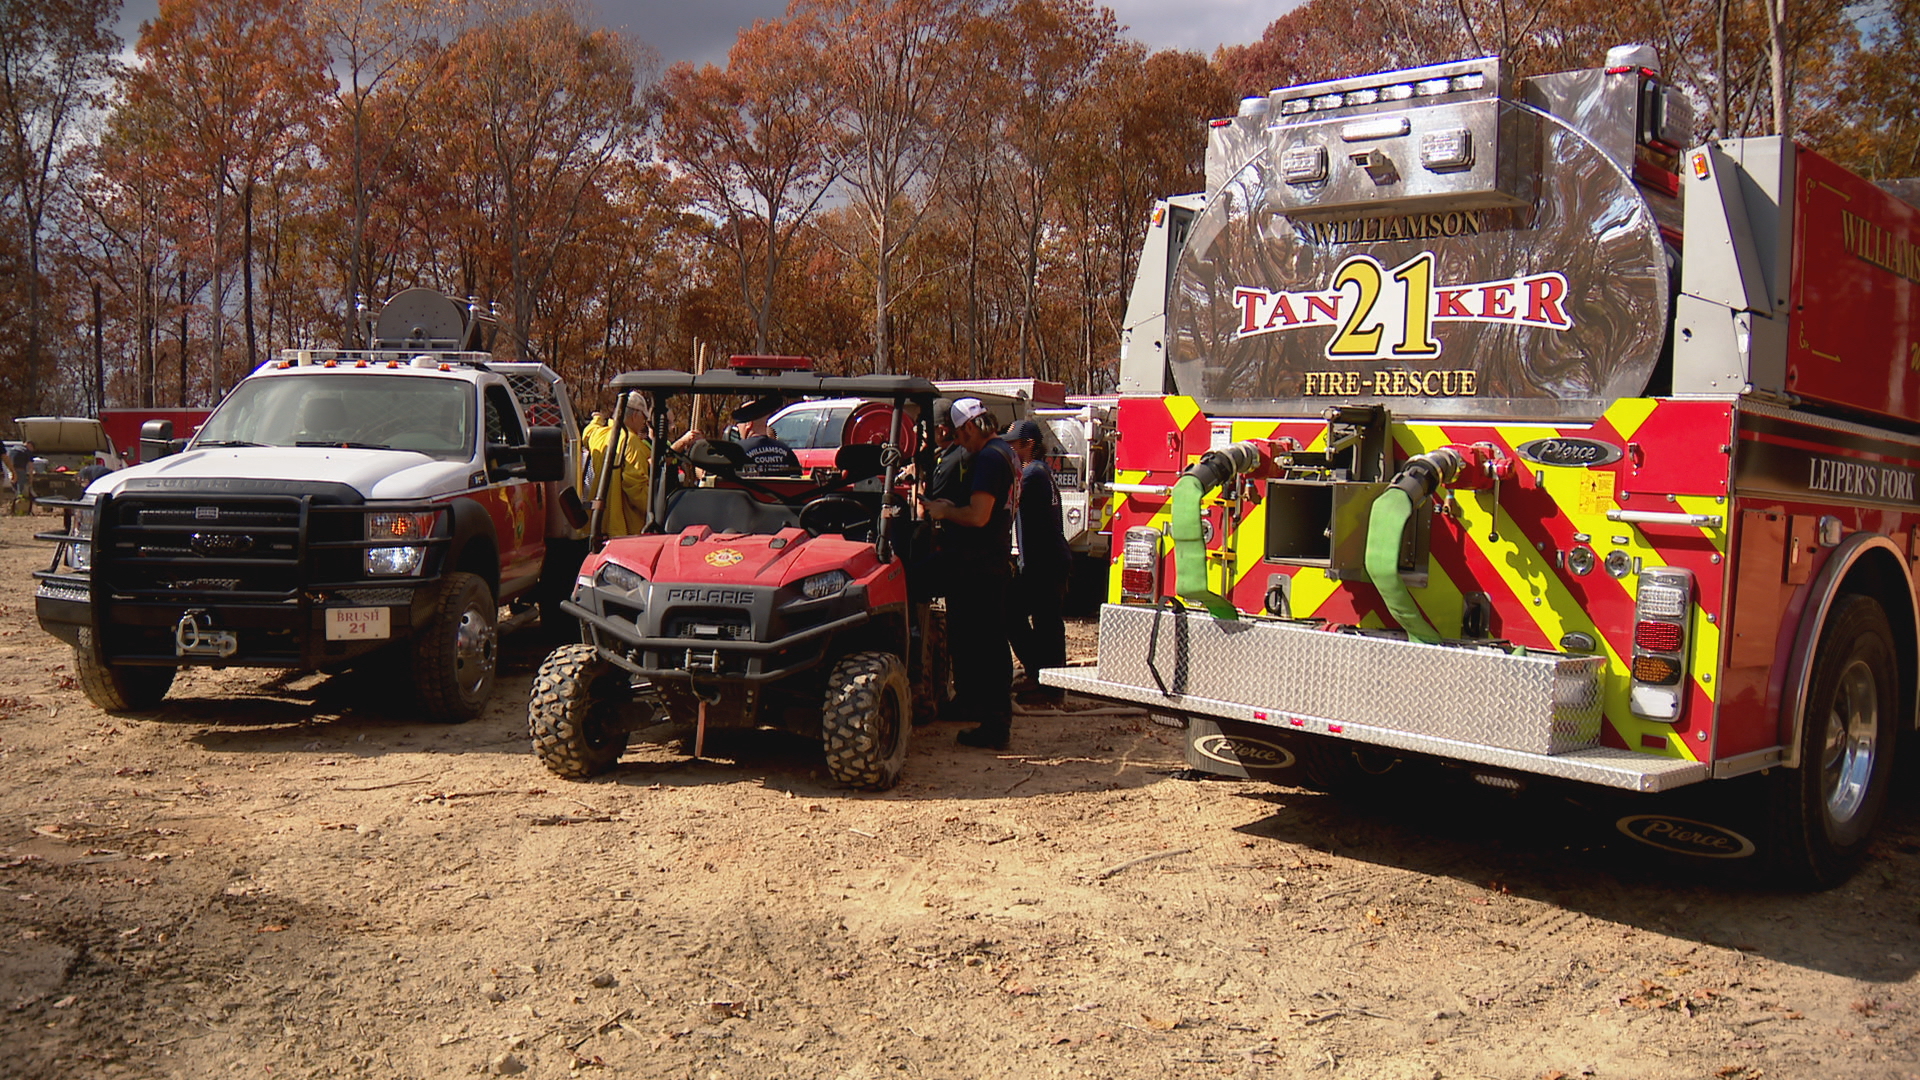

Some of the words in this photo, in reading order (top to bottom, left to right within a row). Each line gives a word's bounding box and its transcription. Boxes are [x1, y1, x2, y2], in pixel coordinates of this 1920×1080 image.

[1314, 211, 1482, 245] WILLIAMSON
[1329, 256, 1438, 356] 21
[1304, 369, 1478, 397] FIRE-RESCUE
[746, 446, 788, 458] WILLIAMSON
[754, 455, 783, 464] COUNTY
[1537, 440, 1597, 461] Pierce
[1053, 473, 1078, 487] CREEK
[1808, 457, 1877, 497] LEIPER'S
[1880, 468, 1916, 501] FORK
[667, 588, 755, 605] POLARIS
[336, 611, 380, 622] BRUSH
[348, 622, 367, 634] 21
[1212, 738, 1279, 763] Pierce
[1642, 819, 1734, 851] Pierce
